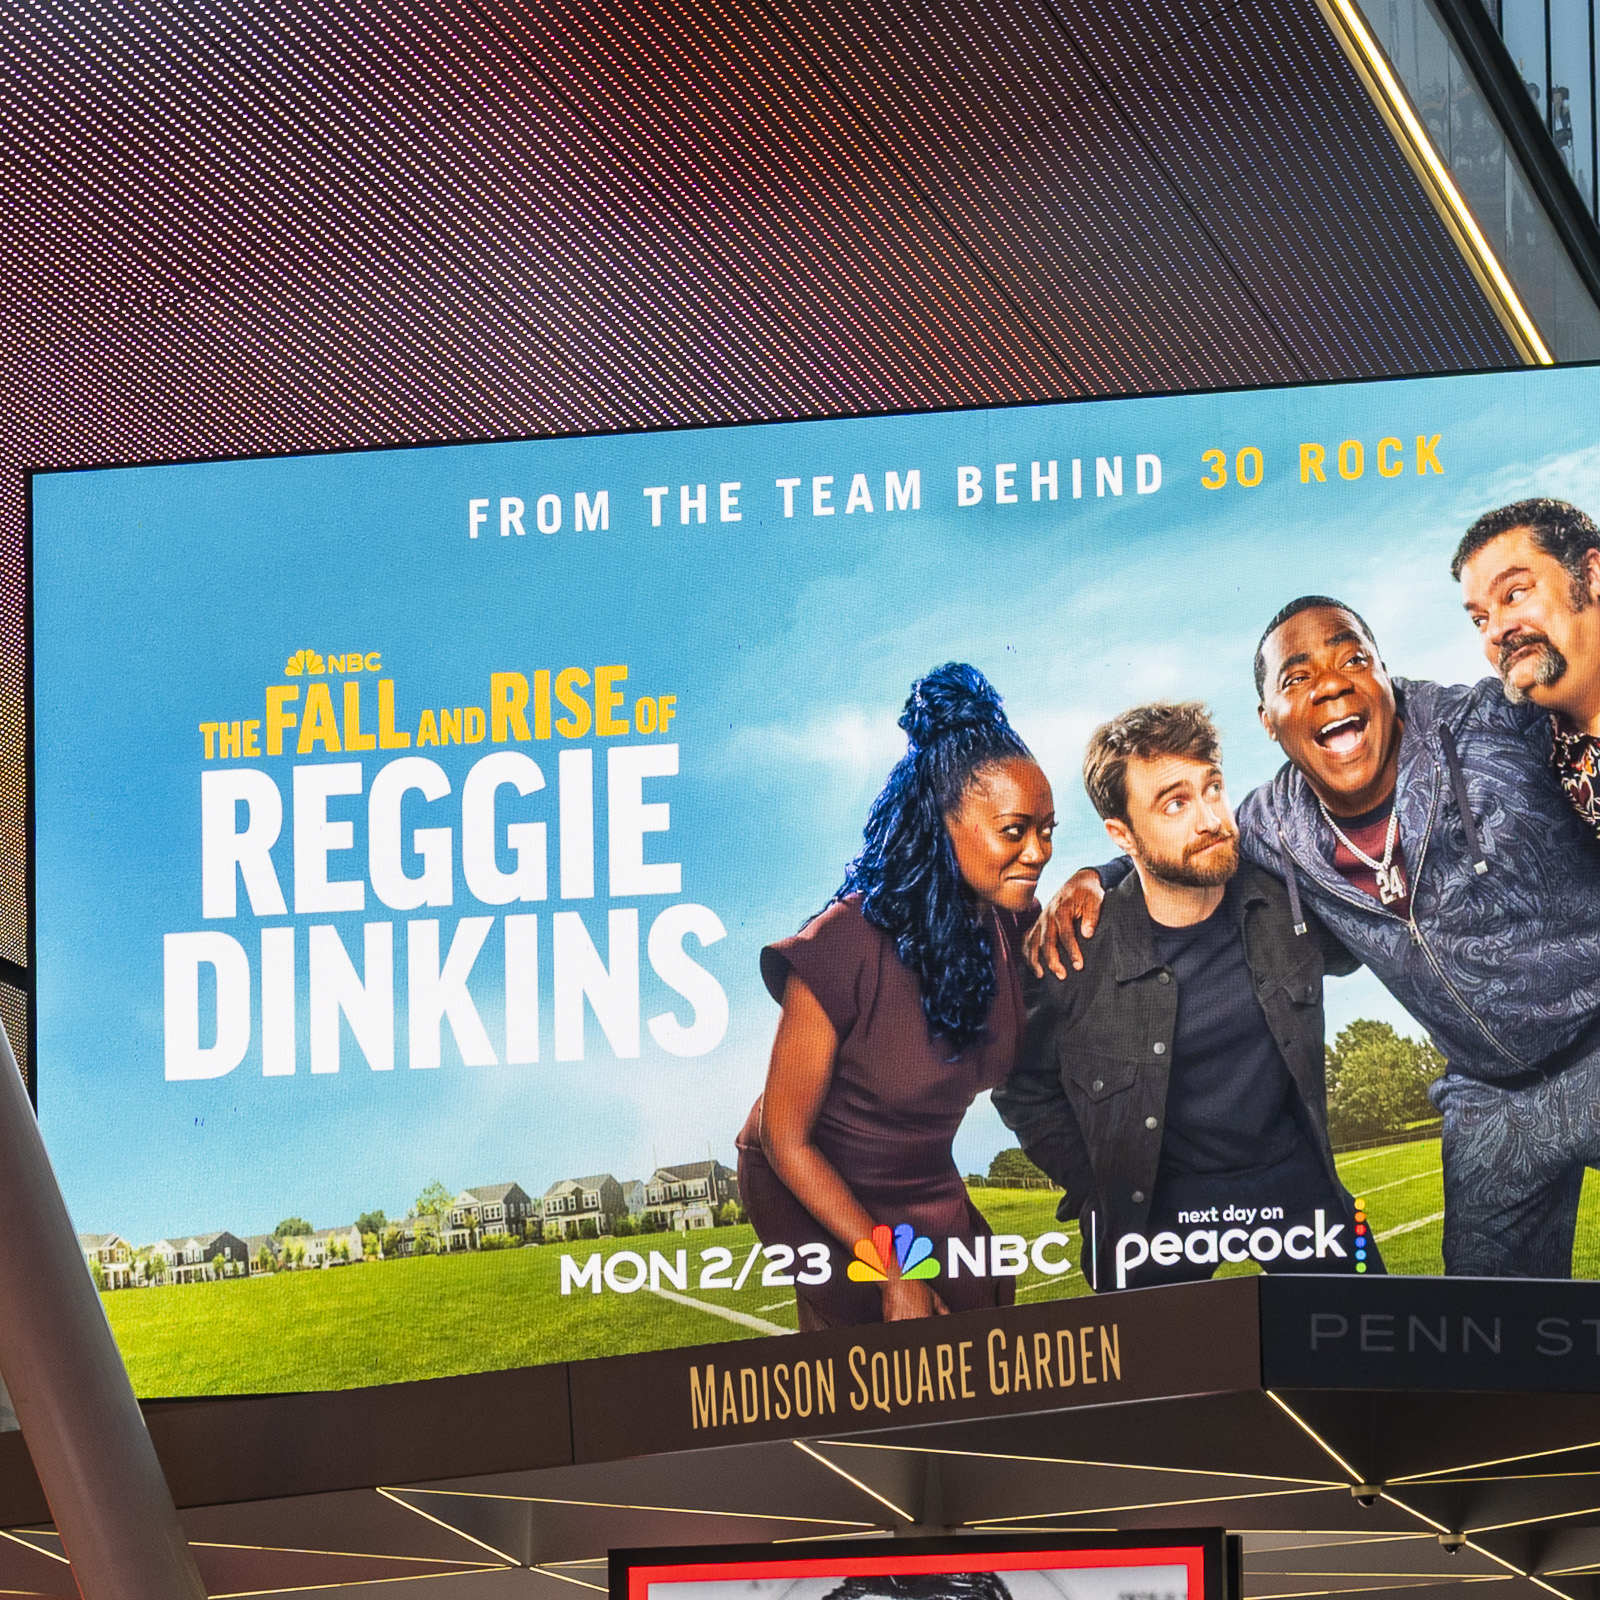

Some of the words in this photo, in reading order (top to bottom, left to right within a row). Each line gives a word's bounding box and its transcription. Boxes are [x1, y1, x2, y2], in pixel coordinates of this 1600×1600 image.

[468, 489, 611, 539] FROM
[643, 480, 743, 528] THE
[776, 469, 922, 519] TEAM
[957, 453, 1163, 508] BEHIND
[1200, 447, 1265, 491] 30
[1298, 433, 1446, 485] ROCK
[328, 651, 382, 674] NBC
[199, 719, 261, 760] THE
[265, 679, 412, 756] FALL
[417, 707, 486, 748] AND
[491, 665, 629, 742] RISE
[636, 695, 677, 734] OF
[201, 743, 683, 919] REGGIE
[1376, 865, 1406, 905] 24
[163, 902, 730, 1082] DINKINS
[1116, 1209, 1348, 1289] peacock
[1178, 1210, 1219, 1224] next
[1223, 1204, 1257, 1226] day
[1260, 1207, 1284, 1221] on
[560, 1248, 689, 1296] MON
[699, 1242, 833, 1292] 2/23
[948, 1231, 1071, 1278] NBC
[1310, 1312, 1503, 1356] PENN
[690, 1357, 836, 1430] MADISON
[849, 1341, 977, 1414] SQUARE
[987, 1323, 1122, 1396] GARDEN
